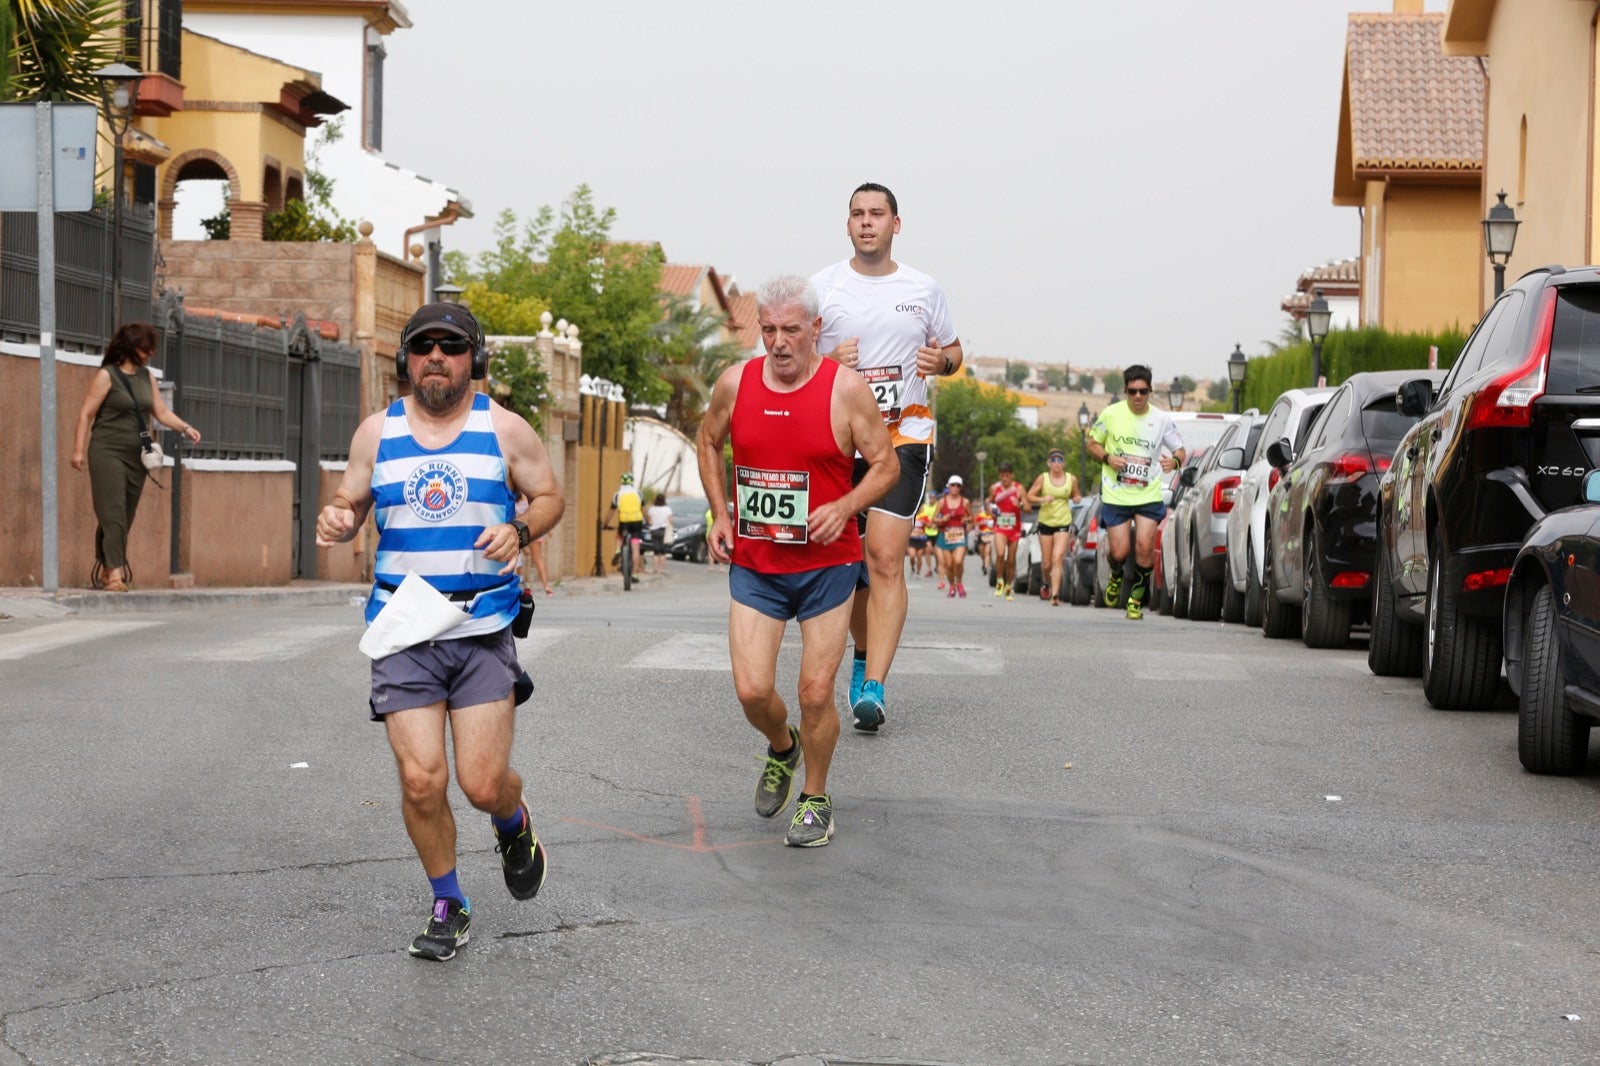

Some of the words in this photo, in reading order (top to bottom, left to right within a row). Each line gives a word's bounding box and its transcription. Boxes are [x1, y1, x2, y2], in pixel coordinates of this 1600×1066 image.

[407, 468, 426, 503] PENYA
[428, 463, 464, 500] RUNNERS
[750, 470, 761, 480] GRAN
[762, 472, 779, 482] PREMIO
[780, 473, 787, 482] DE
[787, 474, 804, 483] FONDO
[415, 504, 457, 519] ESPANYOL
[746, 491, 796, 519] 405
